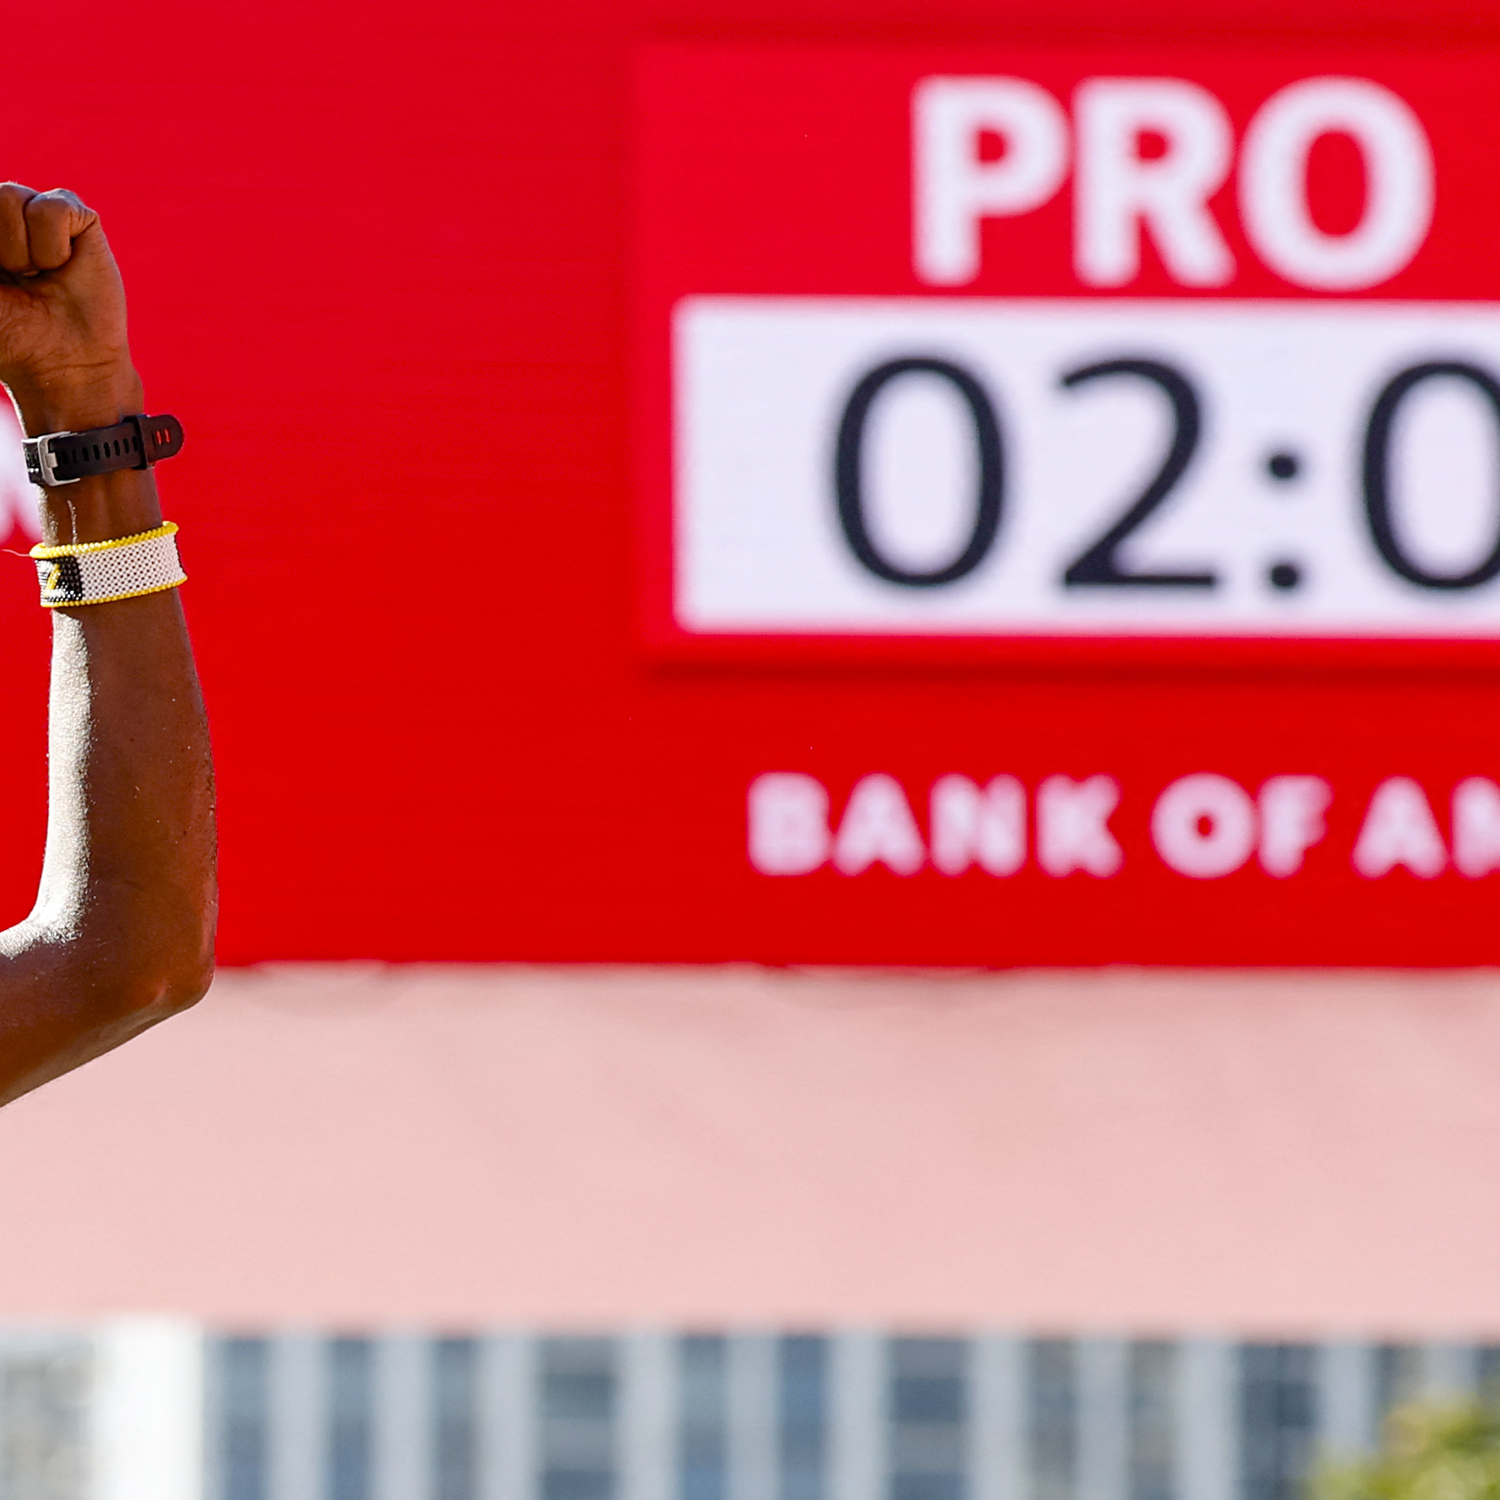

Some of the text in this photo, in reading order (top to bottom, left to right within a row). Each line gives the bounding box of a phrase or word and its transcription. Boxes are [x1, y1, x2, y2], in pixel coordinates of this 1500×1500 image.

[910, 74, 1436, 290] PRO
[747, 772, 1123, 876] BANK
[1151, 774, 1333, 879] OF
